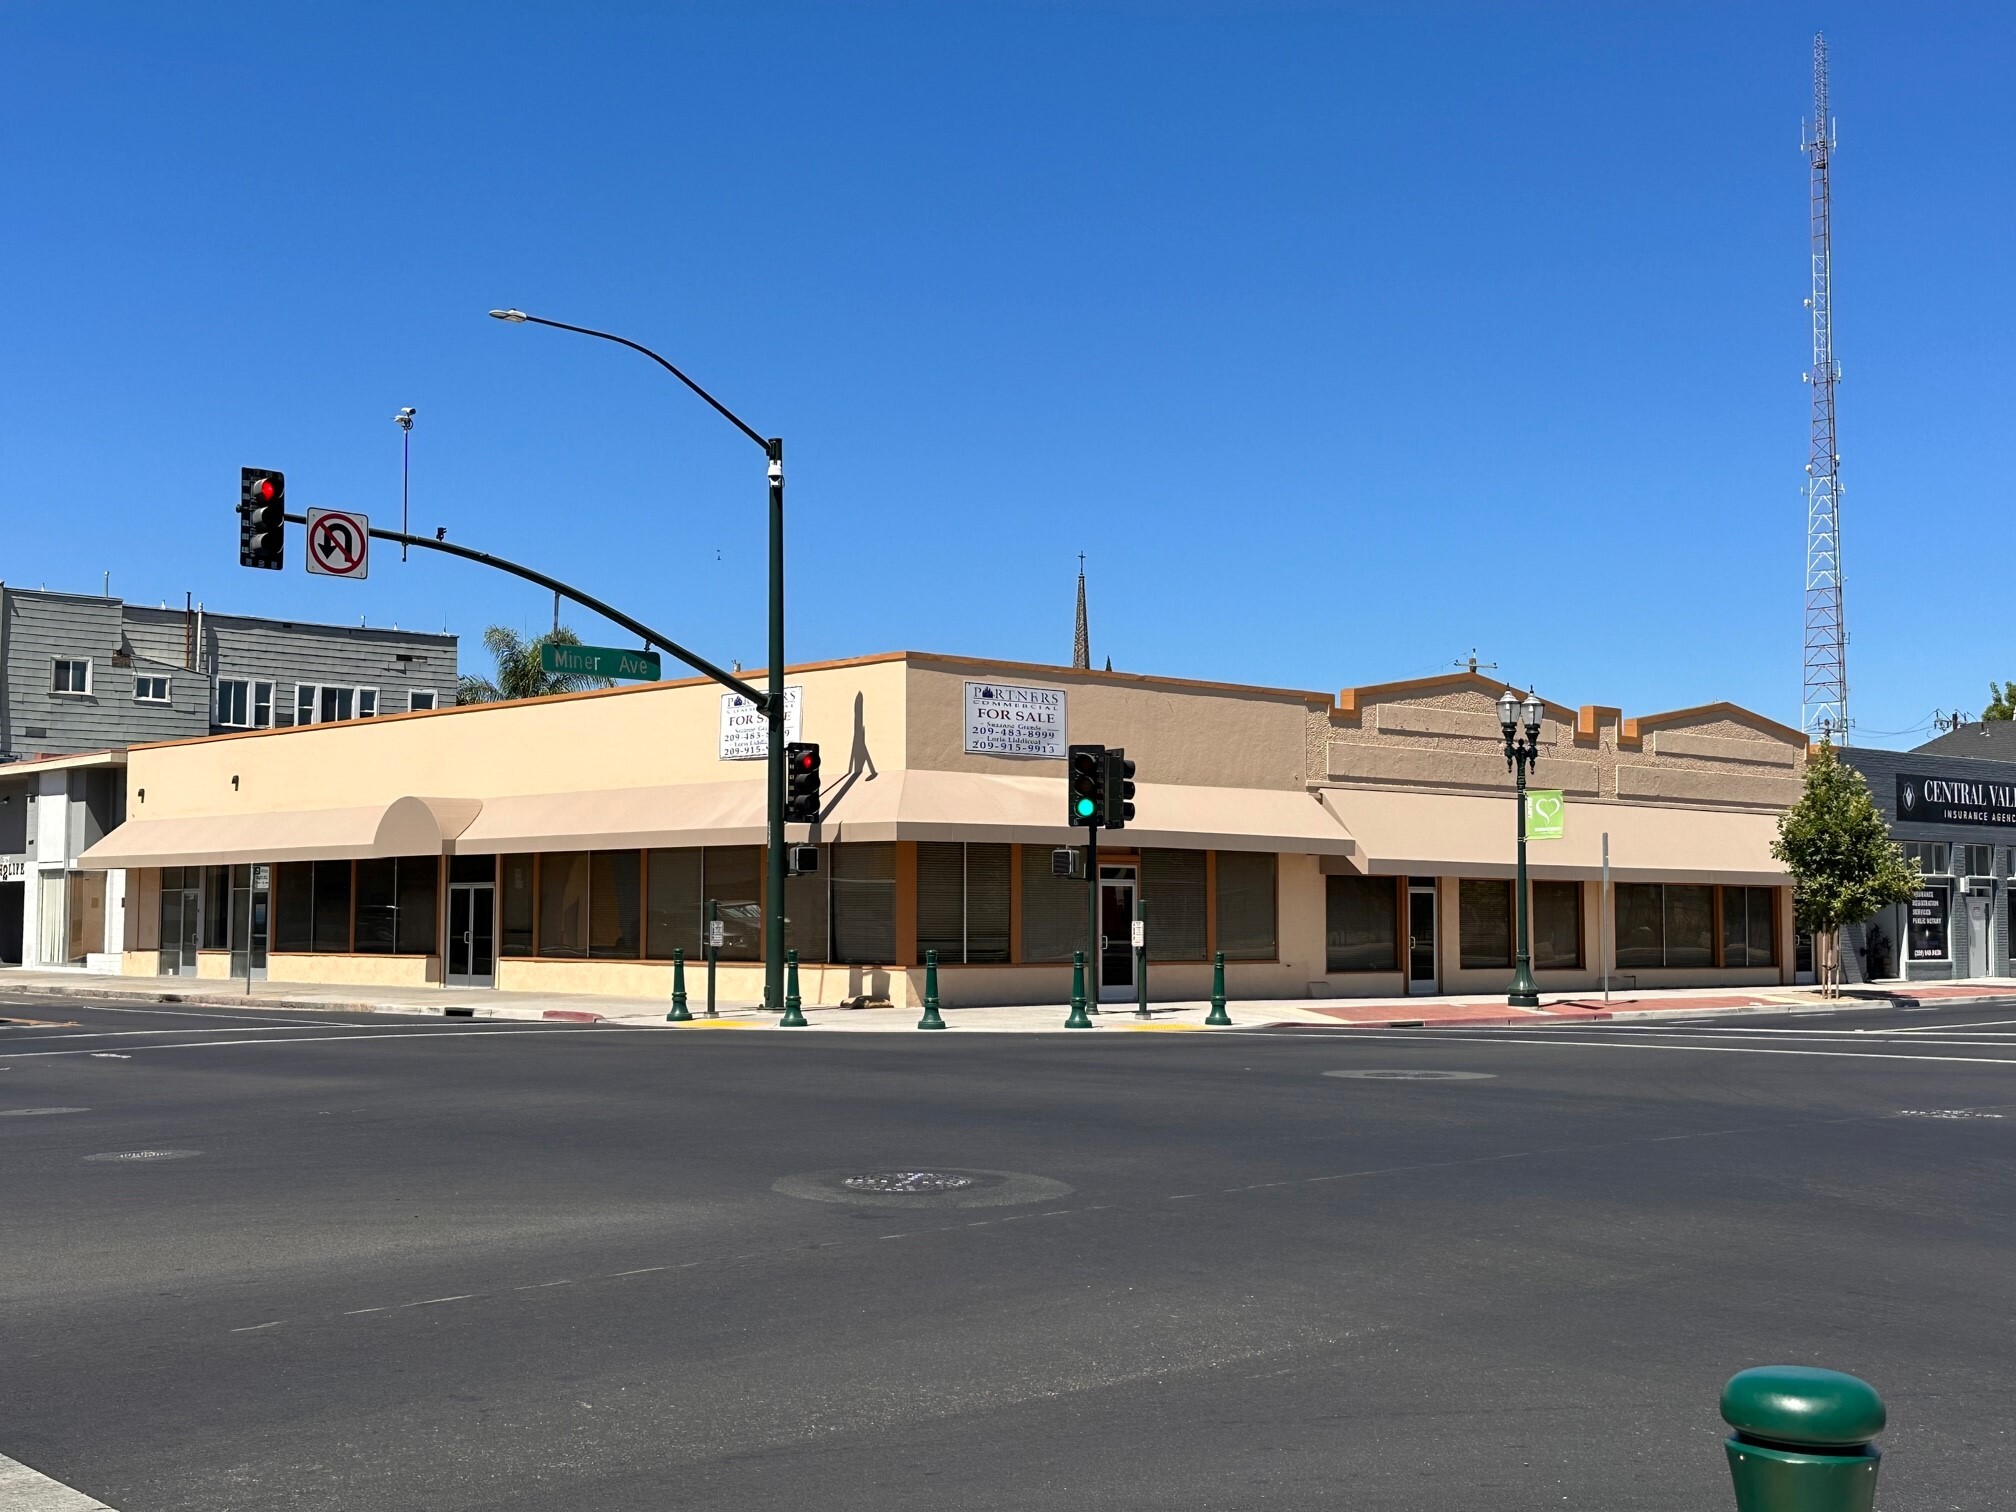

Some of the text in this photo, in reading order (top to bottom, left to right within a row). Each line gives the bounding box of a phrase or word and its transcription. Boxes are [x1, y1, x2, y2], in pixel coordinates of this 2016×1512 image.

[555, 650, 648, 674] Miner Ave
[973, 700, 1058, 711] COMMERCIAL
[729, 711, 792, 726] FOR SE
[978, 708, 1055, 724] FOR SALE
[972, 727, 1055, 739] 209-483-8999
[972, 740, 1055, 753] 209-915-9913
[1924, 779, 1987, 806] CENTRAL
[1944, 809, 1988, 821] INSURANCE
